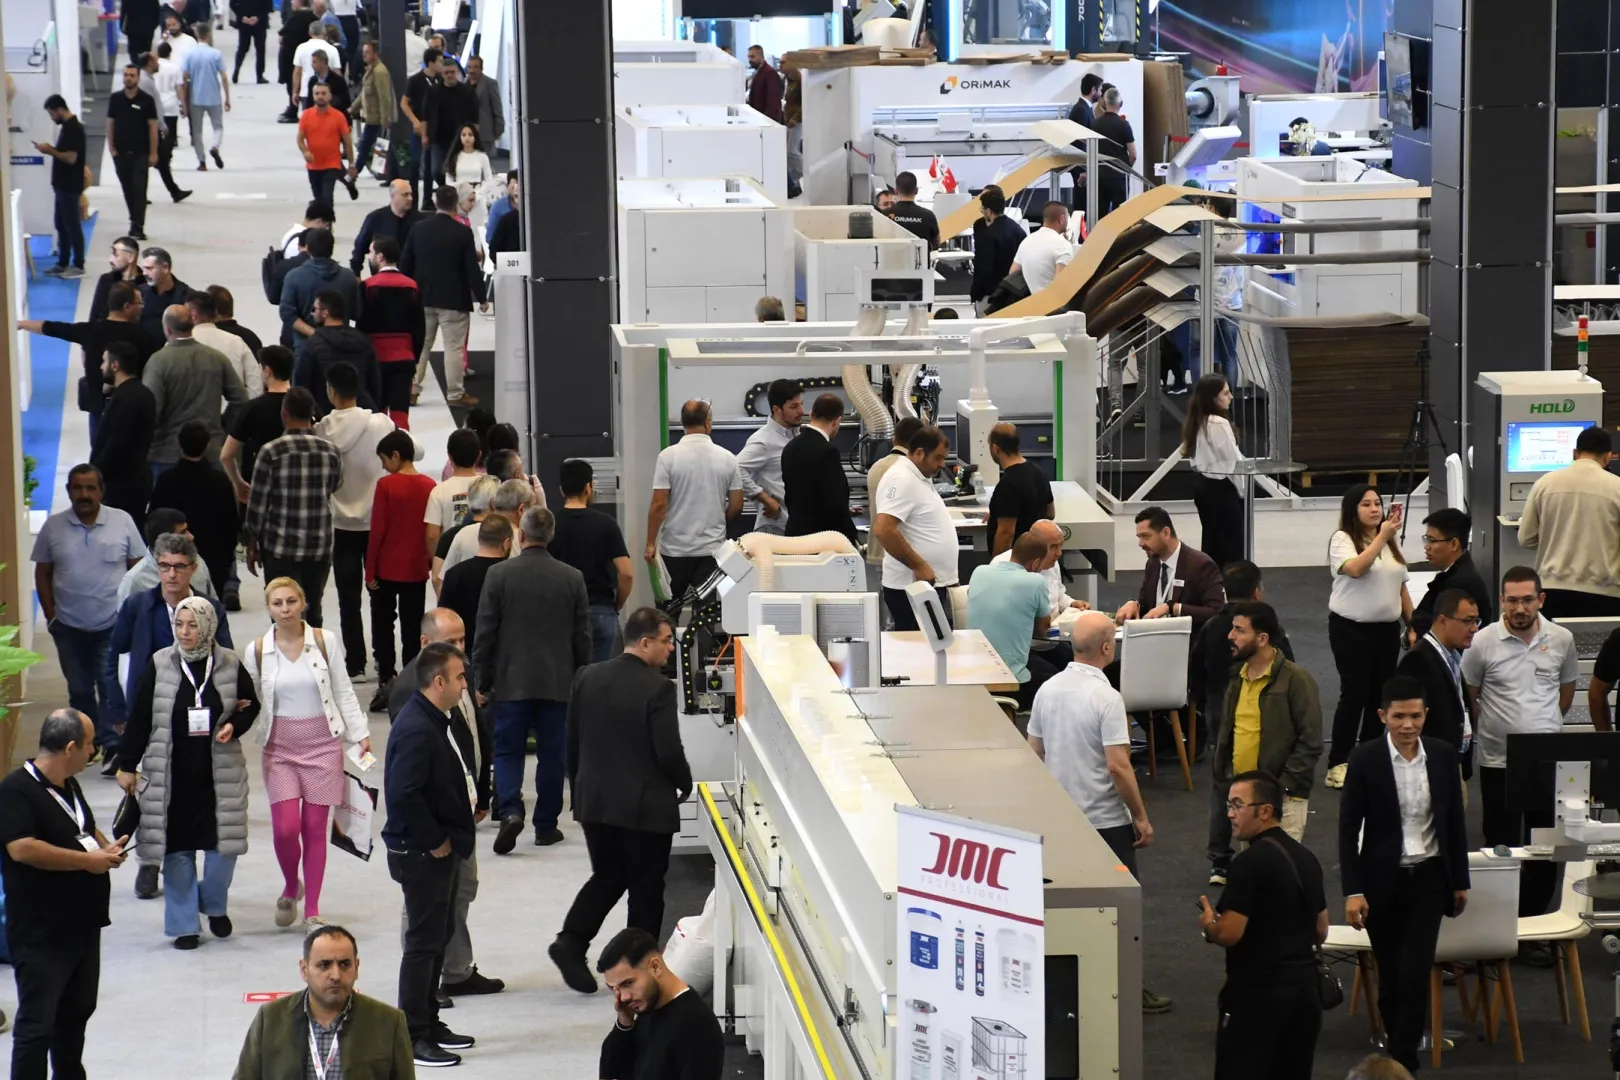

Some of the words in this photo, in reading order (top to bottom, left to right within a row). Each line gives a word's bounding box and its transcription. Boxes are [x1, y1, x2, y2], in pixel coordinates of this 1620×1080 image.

[506, 259, 520, 267] 301
[1529, 399, 1575, 414] HOLD
[921, 831, 1017, 891] JMC
